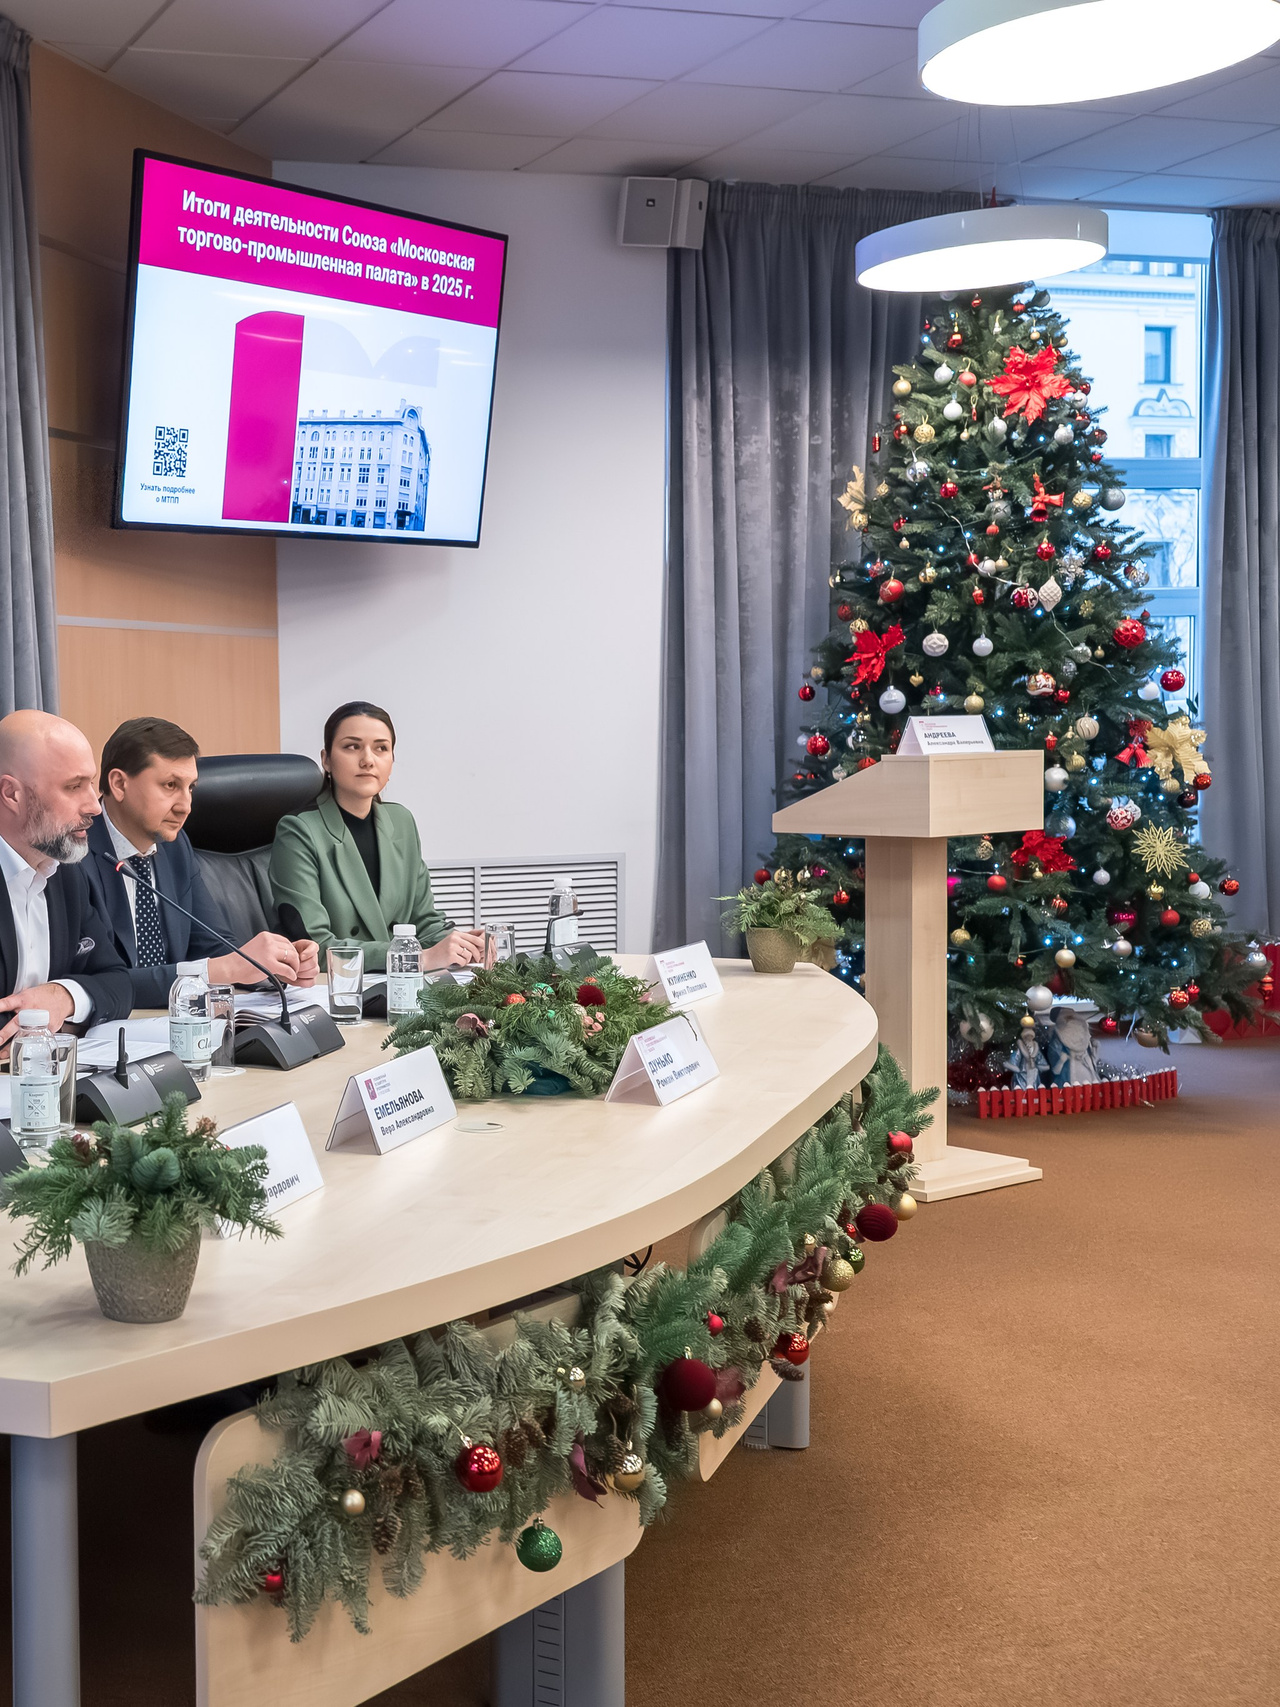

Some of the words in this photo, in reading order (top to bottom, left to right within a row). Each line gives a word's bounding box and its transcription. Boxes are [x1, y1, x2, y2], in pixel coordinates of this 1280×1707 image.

[182, 189, 230, 220] Итоги
[233, 206, 339, 243] деятельности
[342, 225, 387, 254] Союза
[390, 236, 475, 272] «Московская
[177, 225, 362, 278] торгово-промышленная
[365, 263, 418, 288] палата»
[421, 275, 429, 290] в
[432, 273, 463, 298] 2025
[465, 283, 475, 300] г.
[140, 482, 161, 492] Узнать
[162, 485, 195, 494] подробнее
[924, 731, 956, 739] АНДРЕЕВА
[373, 1088, 425, 1121] ЕМЕЛЬЯНОВА
[380, 1123, 396, 1136] Вера
[395, 1105, 435, 1129] Александровна
